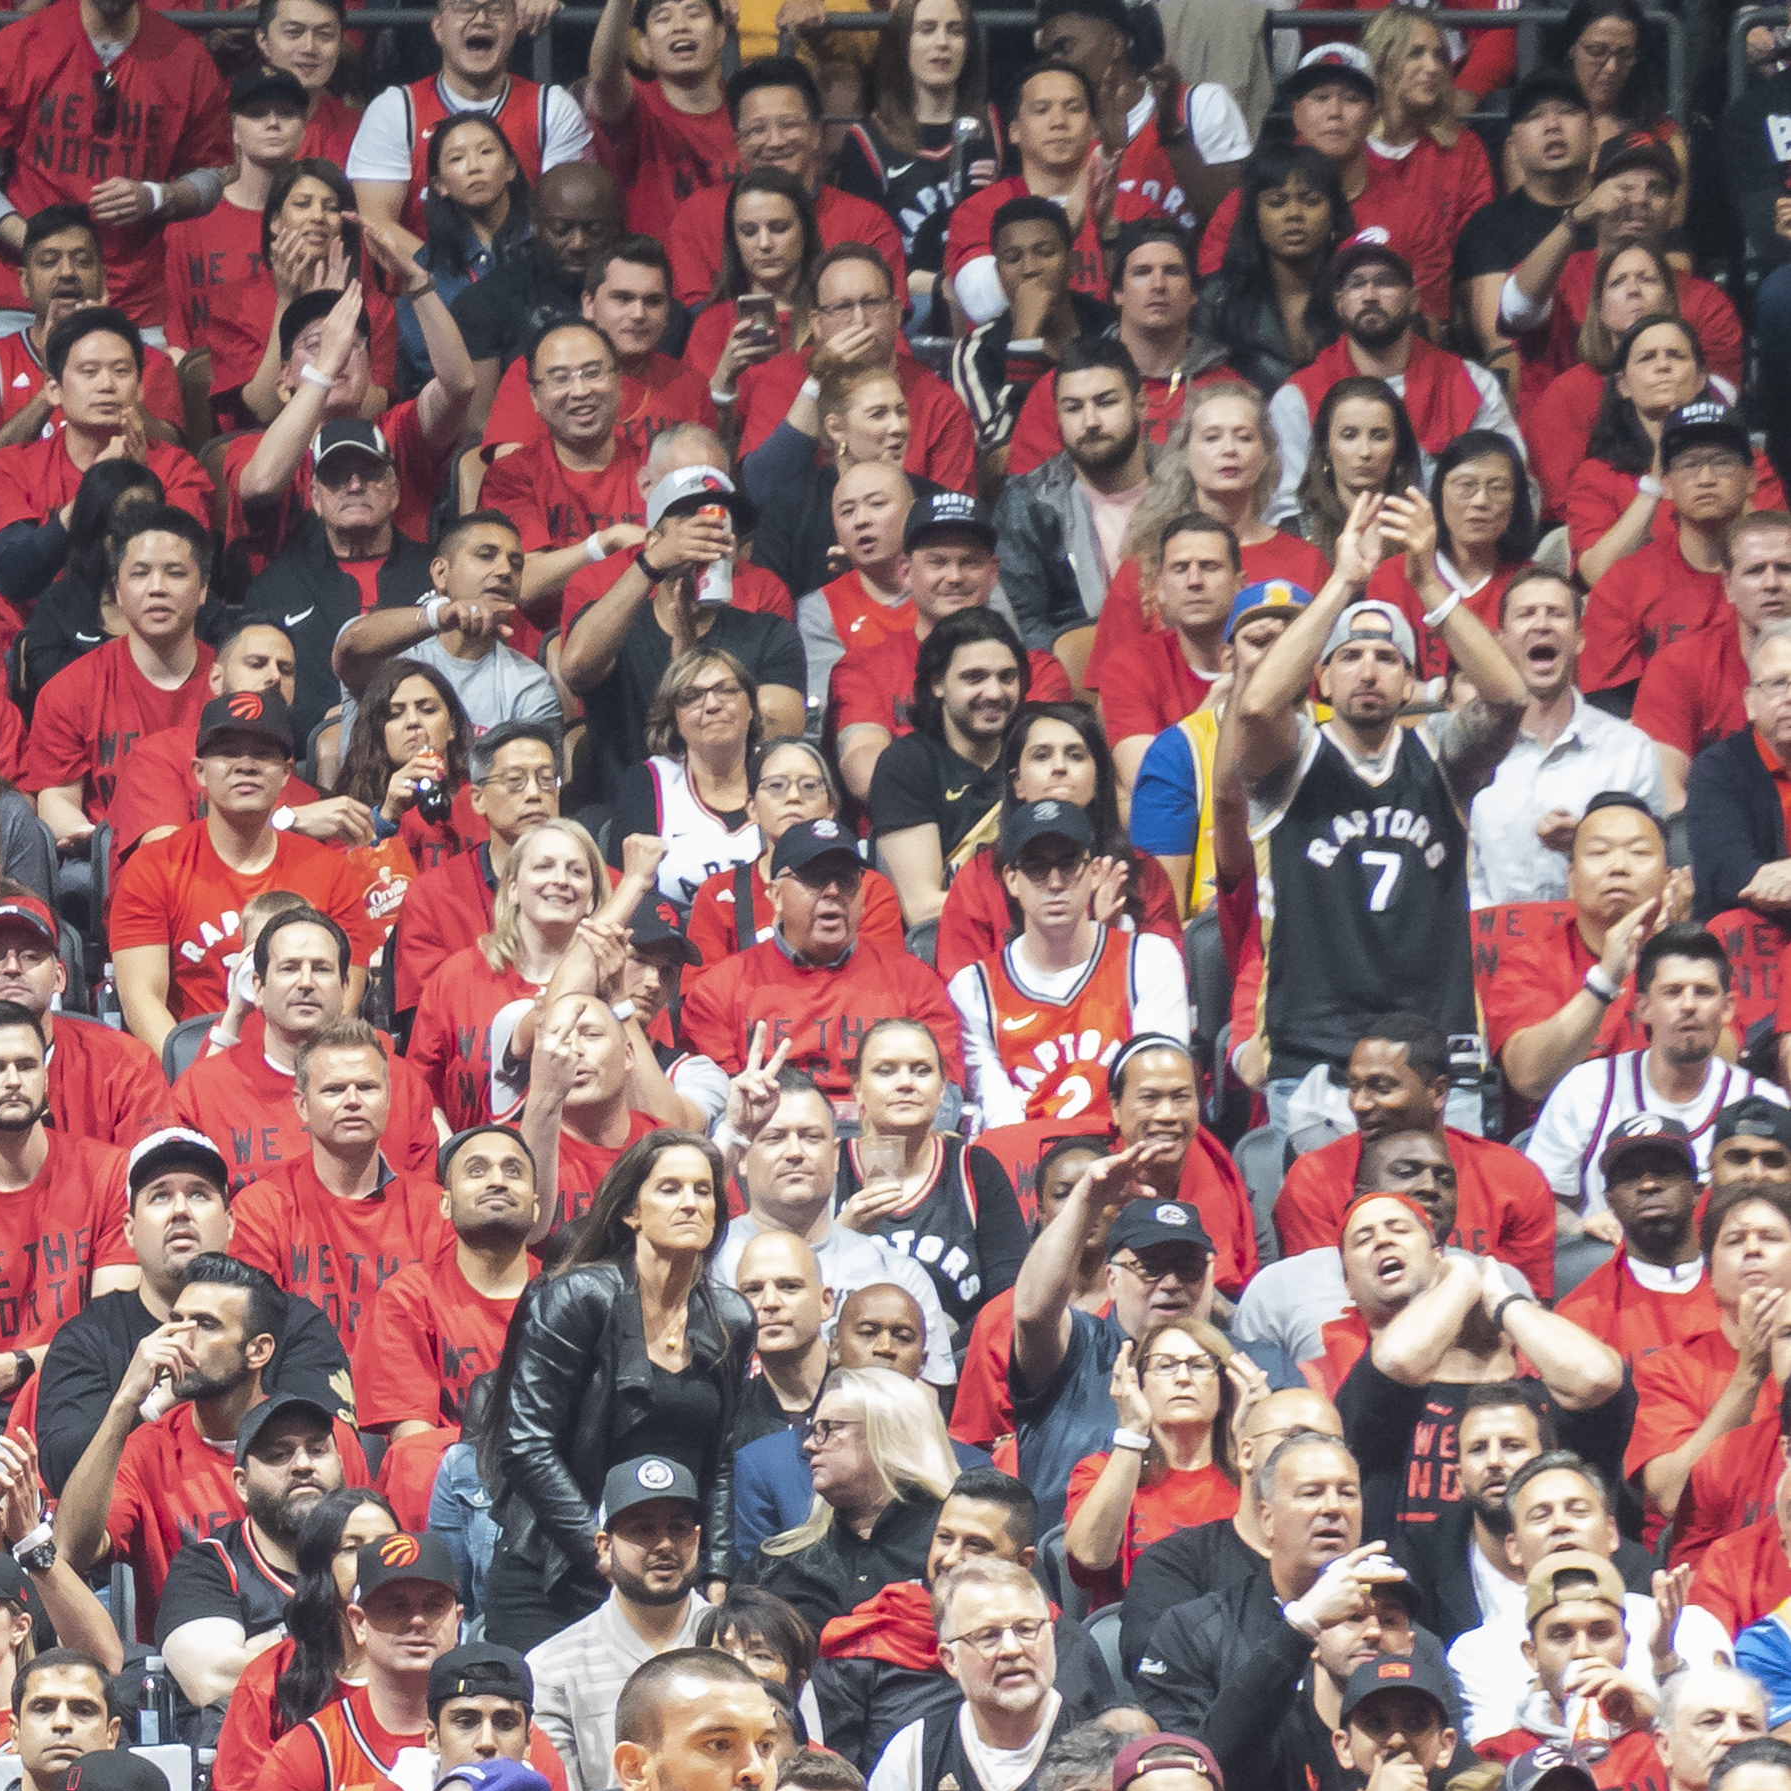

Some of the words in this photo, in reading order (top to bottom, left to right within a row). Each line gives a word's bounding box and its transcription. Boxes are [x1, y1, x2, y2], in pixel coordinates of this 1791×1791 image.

[1306, 806, 1445, 869] RAPTORS
[1360, 850, 1402, 912] 7
[1477, 909, 1525, 937] WE
[230, 1126, 283, 1166] WE
[23, 1226, 90, 1280] THE
[290, 1243, 335, 1285] WE
[1413, 1420, 1457, 1458] WE
